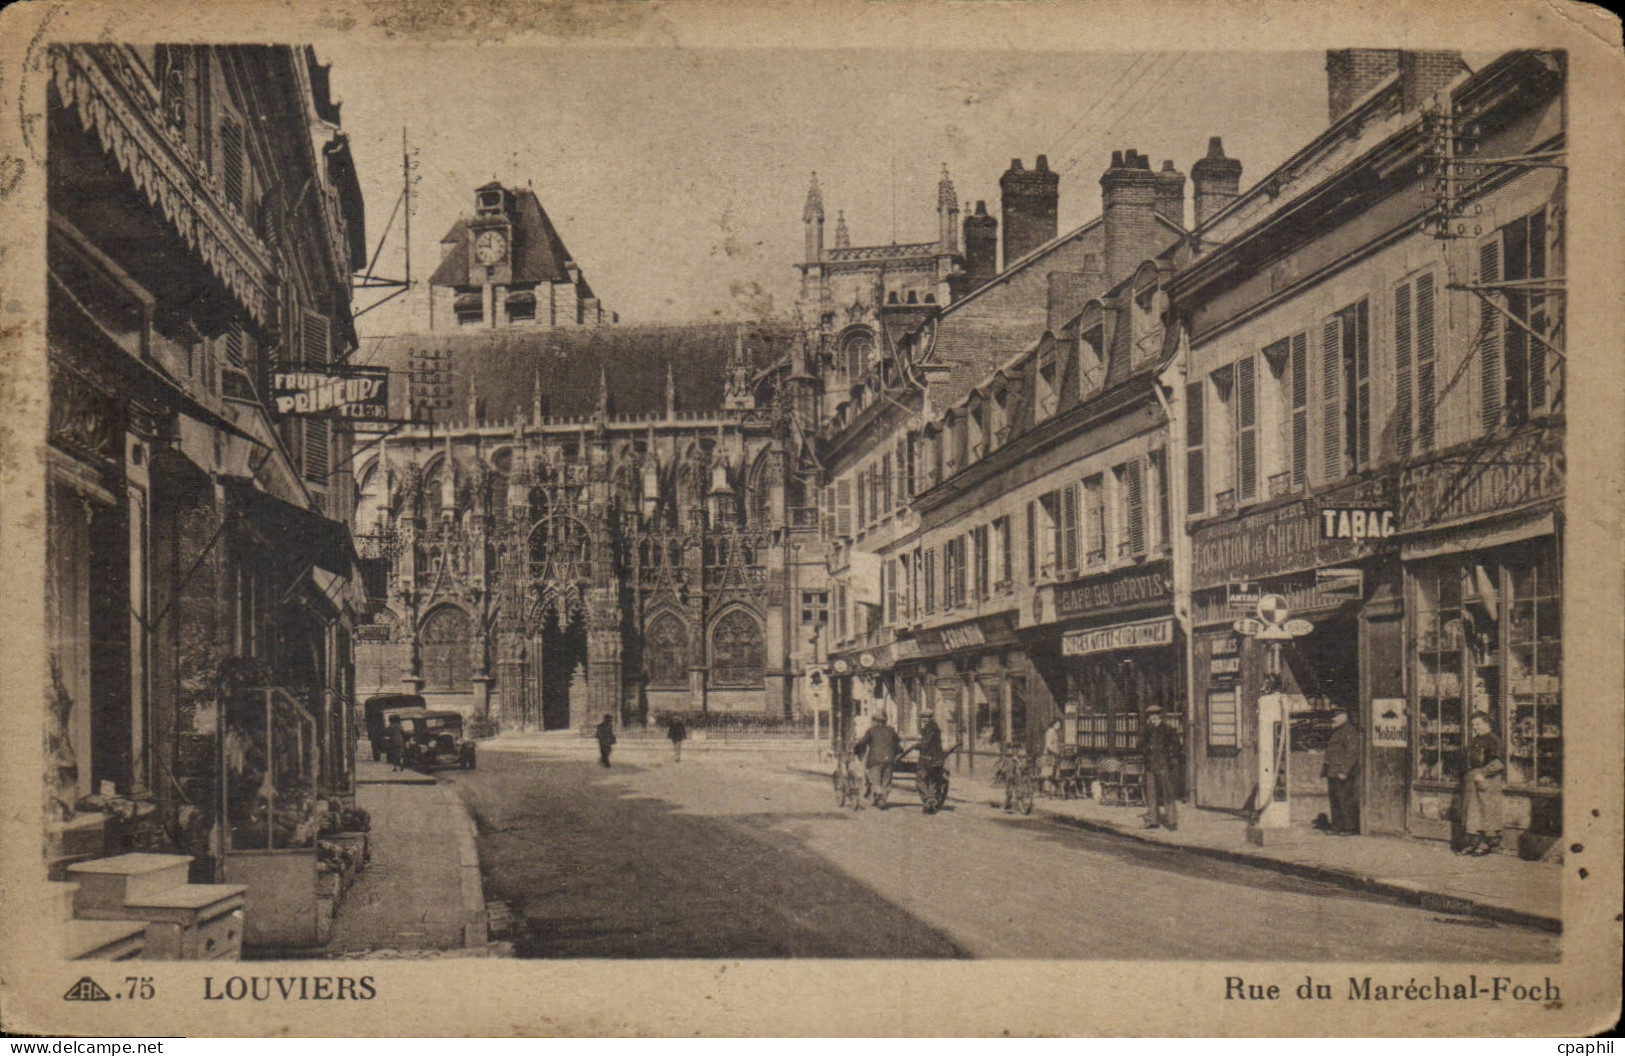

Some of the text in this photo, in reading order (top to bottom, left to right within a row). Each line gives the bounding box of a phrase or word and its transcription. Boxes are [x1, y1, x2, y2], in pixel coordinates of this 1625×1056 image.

[275, 378, 385, 414] PRIMEURS
[1322, 509, 1396, 538] TABAC
[1195, 533, 1251, 574] LOCATION
[1266, 515, 1322, 559] CHEVAU
[1112, 573, 1164, 604] PARVIS
